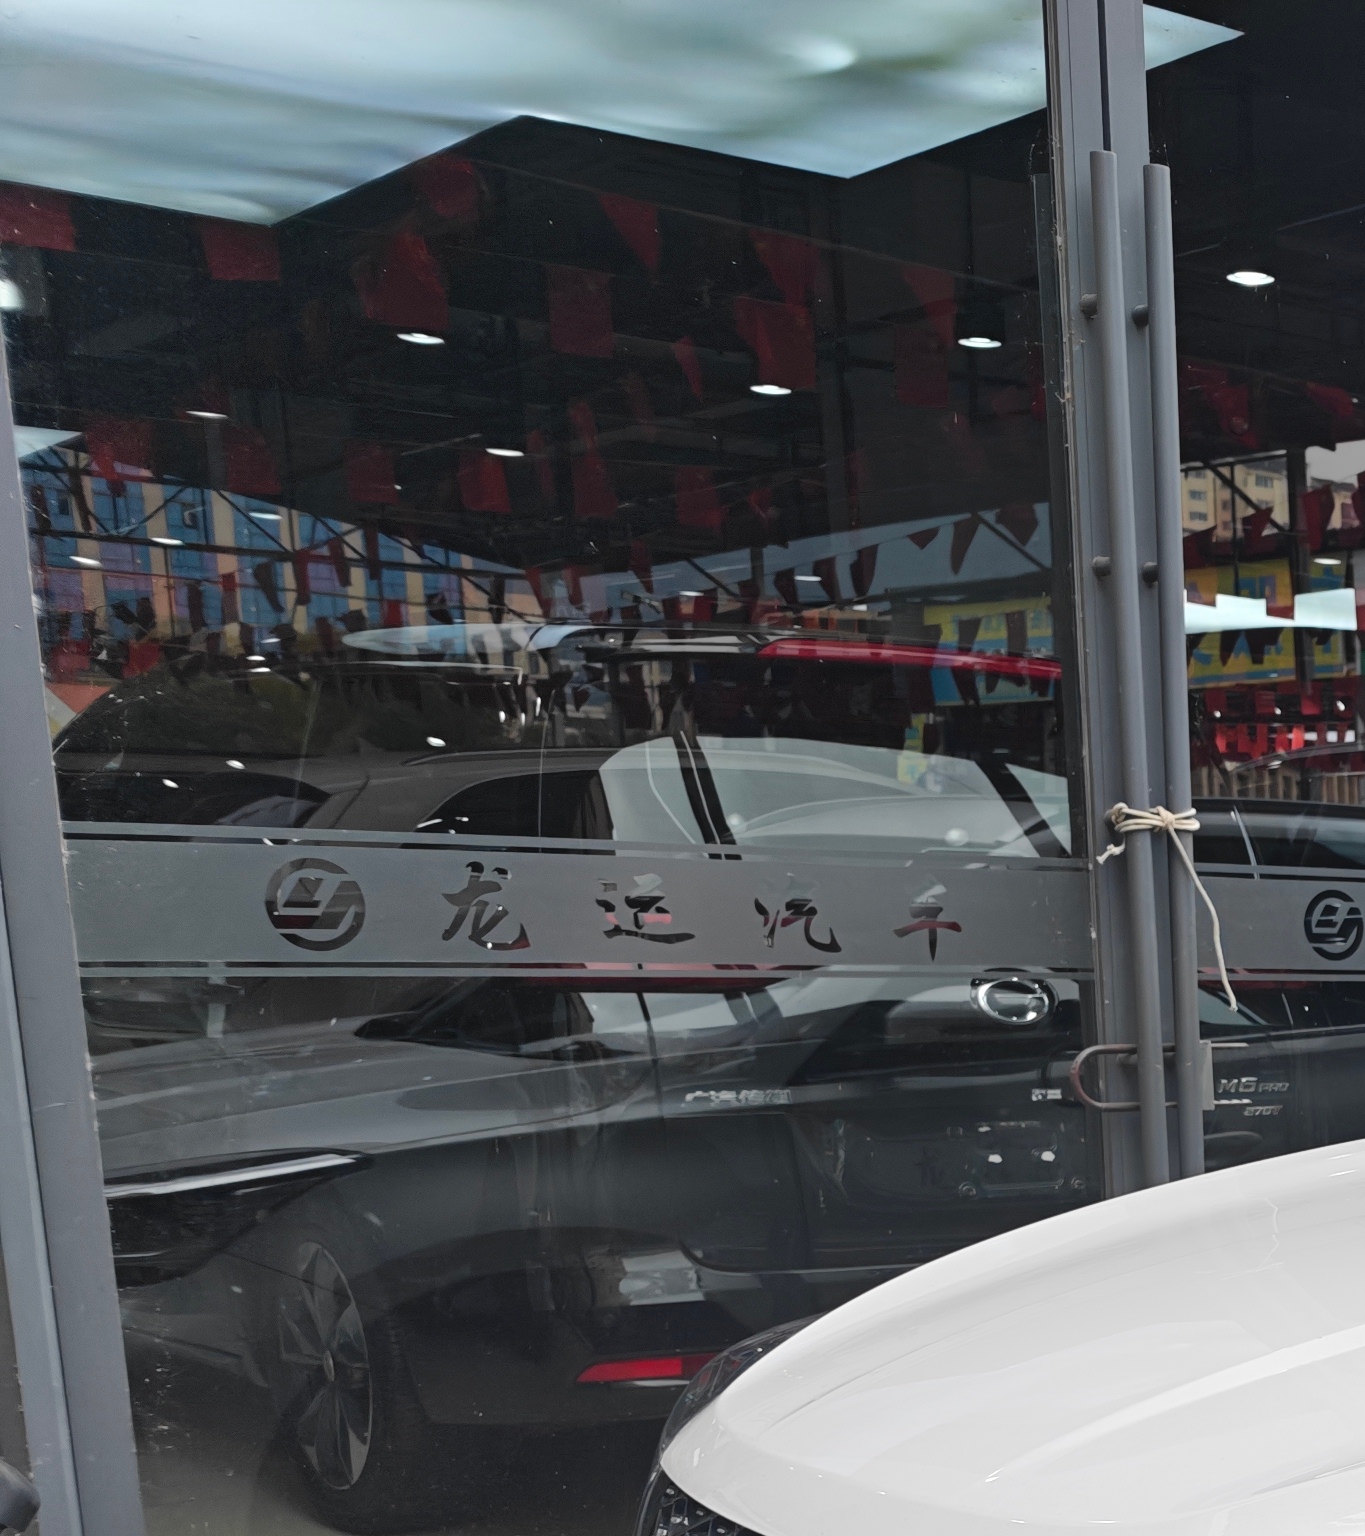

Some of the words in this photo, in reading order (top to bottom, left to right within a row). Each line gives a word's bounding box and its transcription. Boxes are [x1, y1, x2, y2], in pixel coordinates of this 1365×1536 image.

[442, 861, 962, 962] 龙运汽车
[1218, 1077, 1258, 1094] M6
